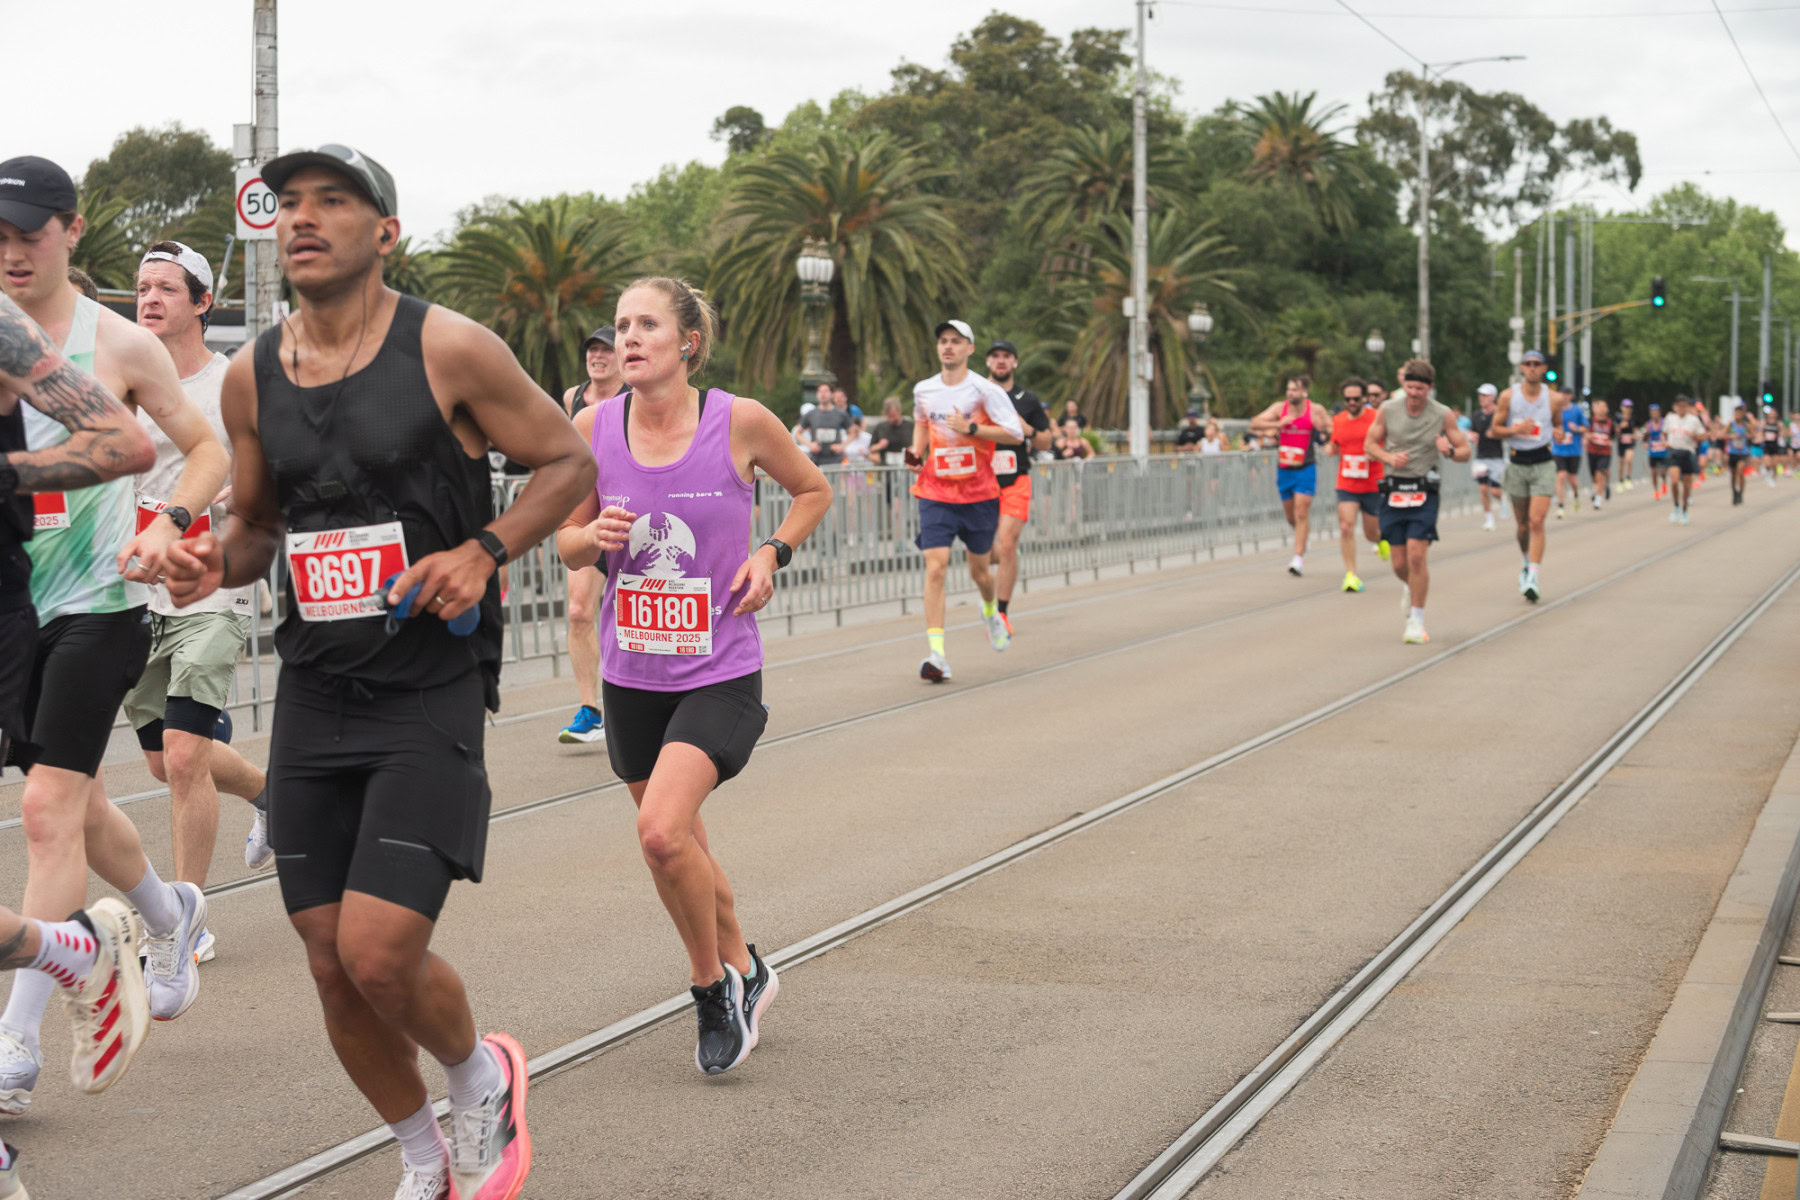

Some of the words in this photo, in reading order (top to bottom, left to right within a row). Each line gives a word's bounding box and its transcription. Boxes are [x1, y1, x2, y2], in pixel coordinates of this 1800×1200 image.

[247, 192, 277, 215] 50
[34, 516, 59, 527] 2025
[305, 549, 381, 600] 8697
[628, 593, 698, 630] 16180
[624, 629, 673, 642] MELBOURNE
[676, 633, 701, 643] 2025
